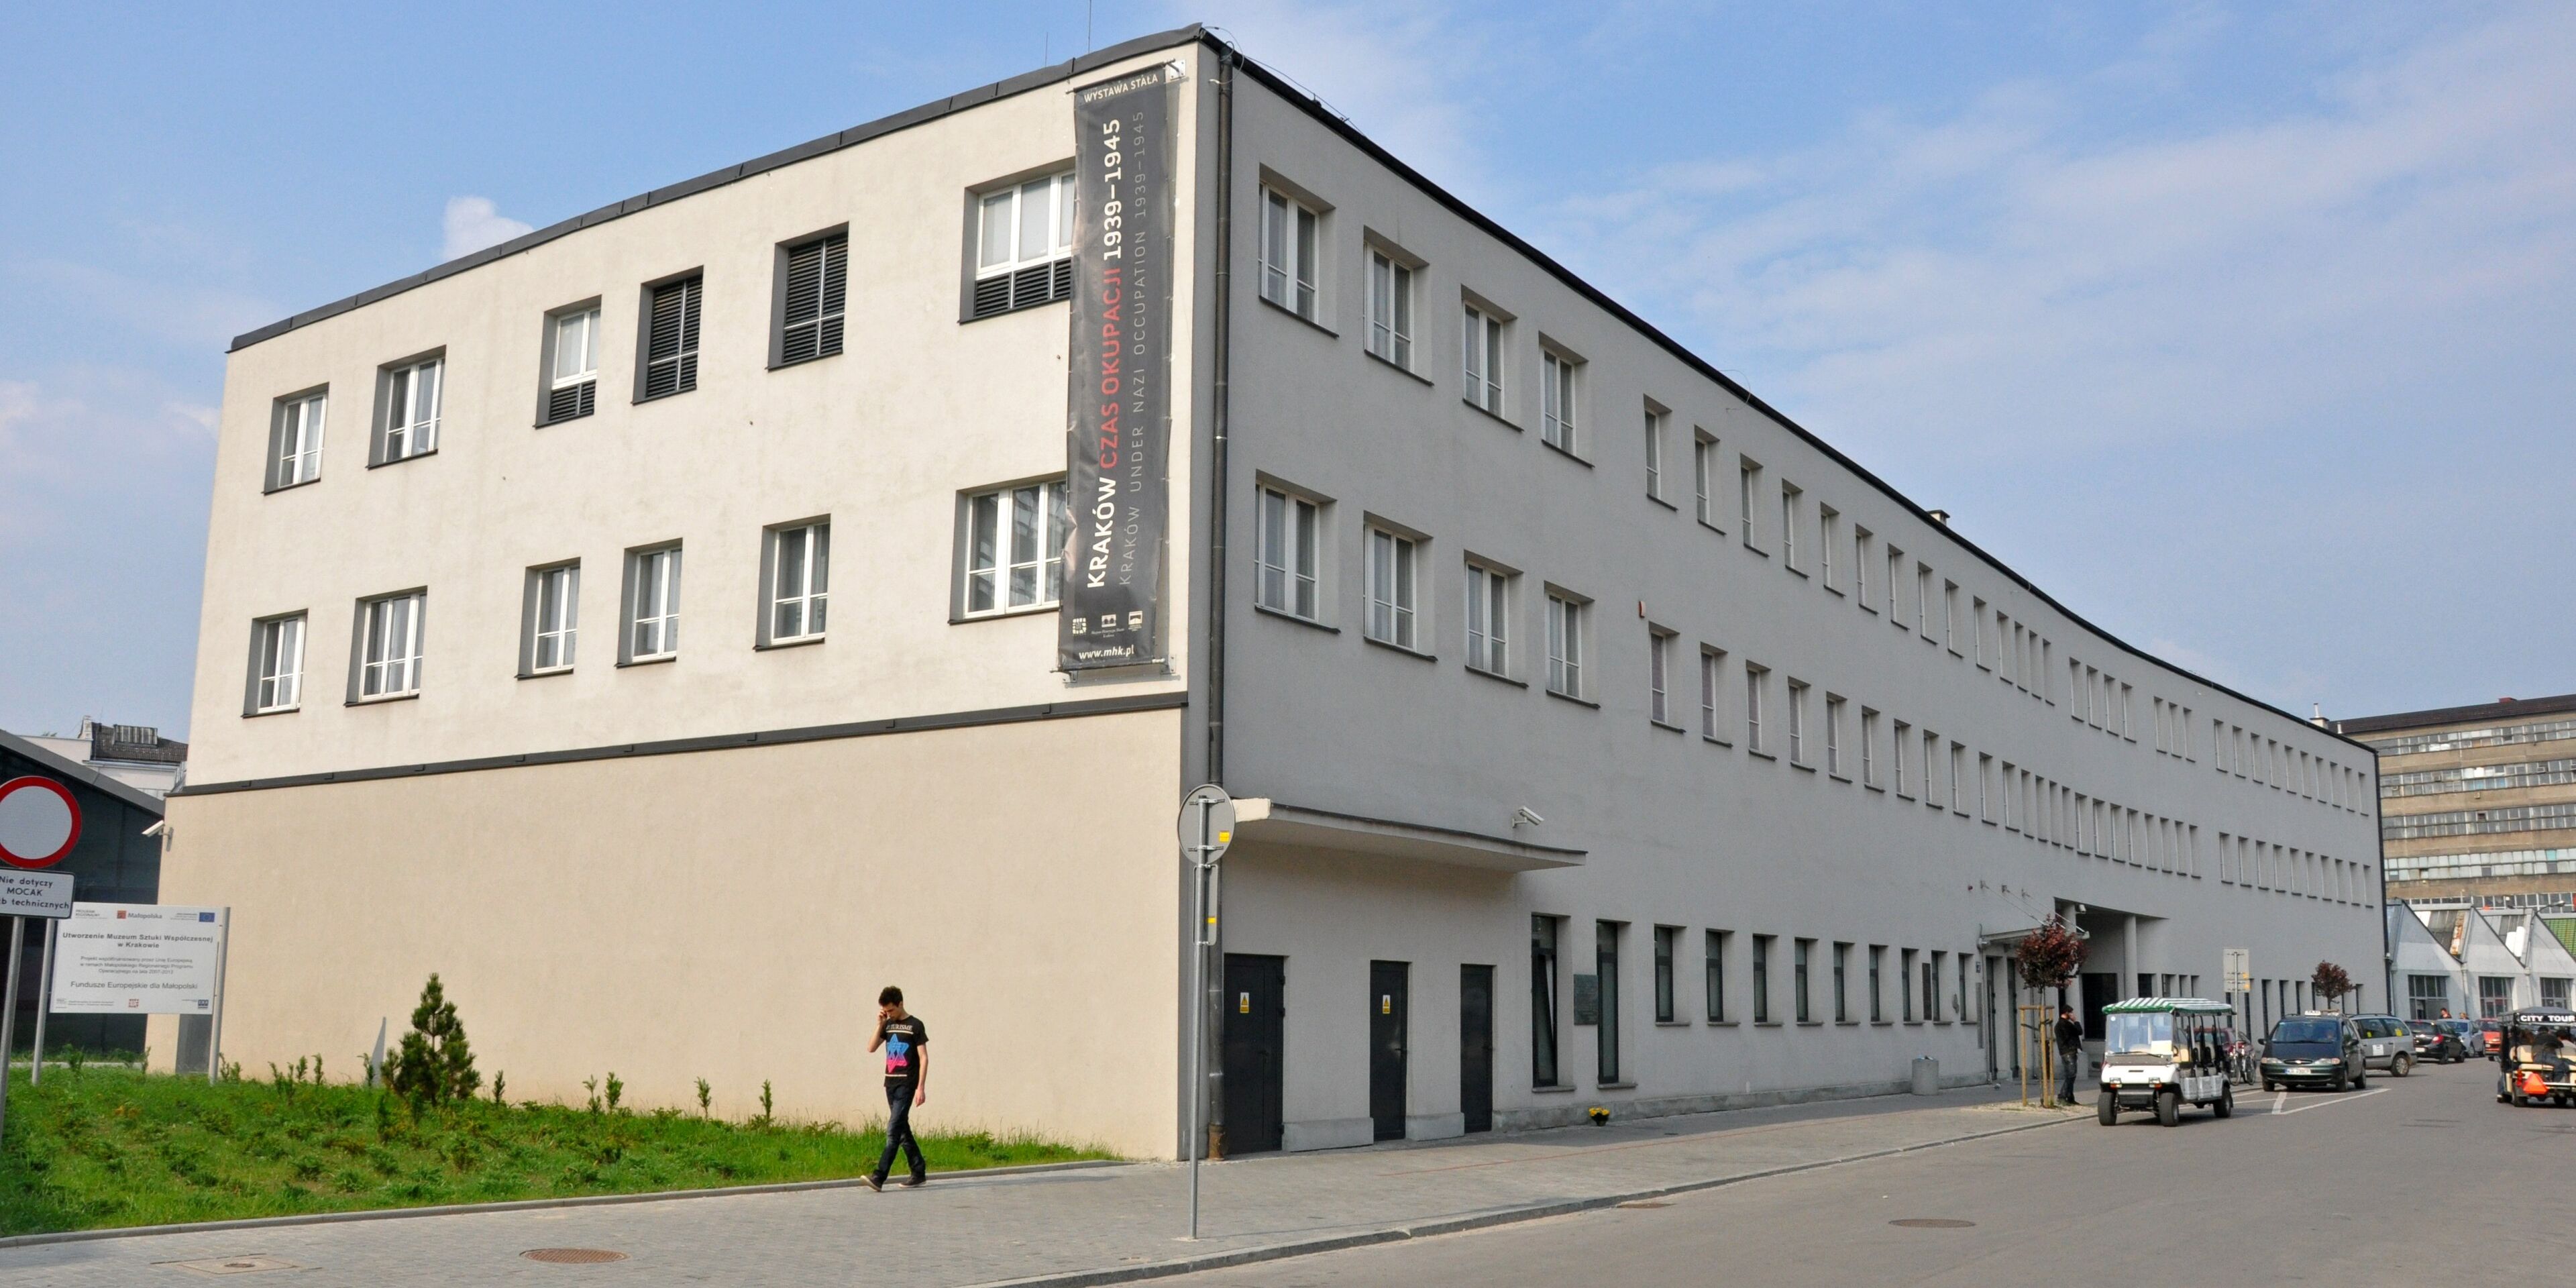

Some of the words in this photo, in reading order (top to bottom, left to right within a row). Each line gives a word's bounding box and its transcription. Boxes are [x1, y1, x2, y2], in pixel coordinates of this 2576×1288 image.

[1084, 83, 1129, 103] WYSTAWA
[1130, 74, 1159, 90] STAŁA
[1134, 231, 1146, 355] OCCUPATION
[1101, 267, 1122, 395] OKUPACJI
[1133, 369, 1144, 413] NAZI
[1100, 402, 1119, 469] CZAS
[1130, 426, 1144, 492] UNDER
[1087, 477, 1116, 588] KRAKÓW
[1119, 506, 1140, 585] KRAKÓW
[1079, 644, 1134, 659] www.mhk.pl
[7, 888, 43, 896] MOCAK
[12, 899, 69, 910] technicznych
[19, 877, 53, 888] dotyczy
[164, 934, 213, 943] Współczesnej
